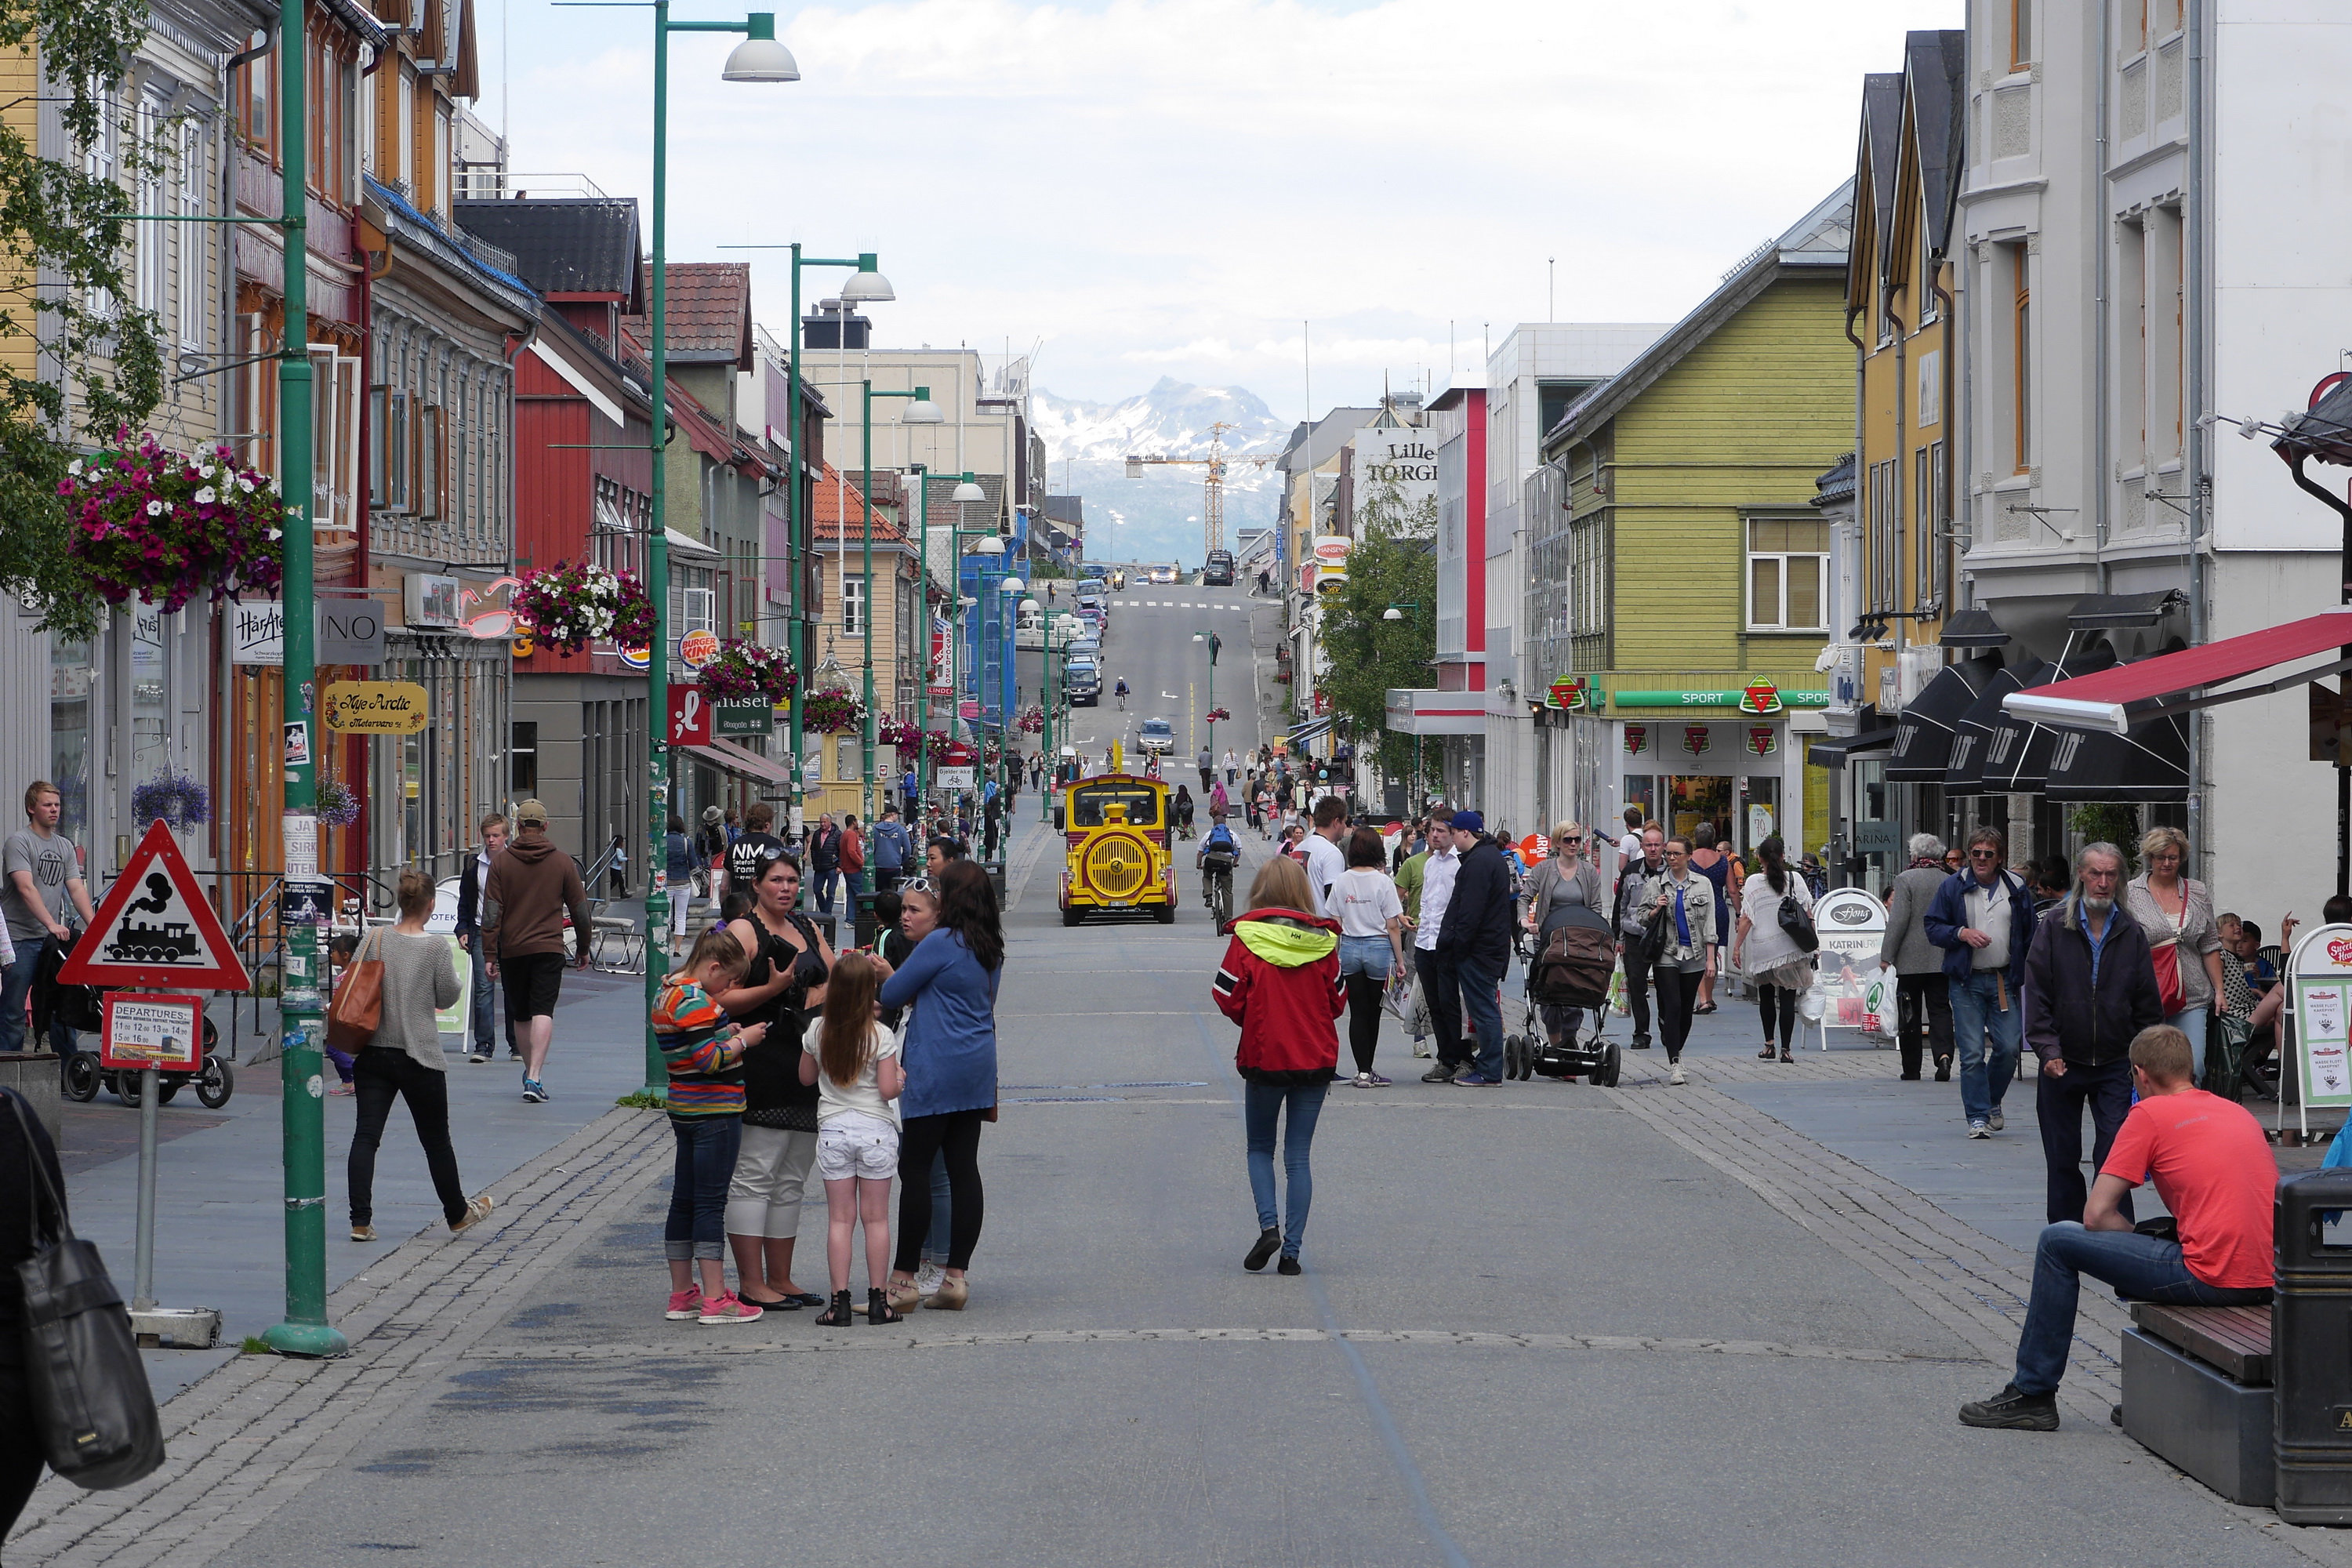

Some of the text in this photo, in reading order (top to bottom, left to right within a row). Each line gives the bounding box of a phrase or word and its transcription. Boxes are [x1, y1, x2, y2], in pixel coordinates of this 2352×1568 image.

[1388, 442, 1435, 460] Lille
[236, 606, 284, 642] HårAte
[321, 615, 376, 640] NO
[682, 637, 716, 649] BURGER
[683, 644, 717, 659] KING
[339, 693, 411, 715] Nye Arctic
[1682, 693, 1724, 703] SPORT
[1797, 693, 1830, 703] SPOR
[295, 820, 310, 831] JA
[1537, 833, 1548, 853] ARK
[1845, 834, 1890, 844] ARINA
[291, 841, 317, 853] SIRK
[732, 843, 764, 859] NM
[287, 862, 315, 874] UTEN
[116, 1006, 187, 1021] DEPARTURES:
[2339, 1411, 2352, 1428] A
